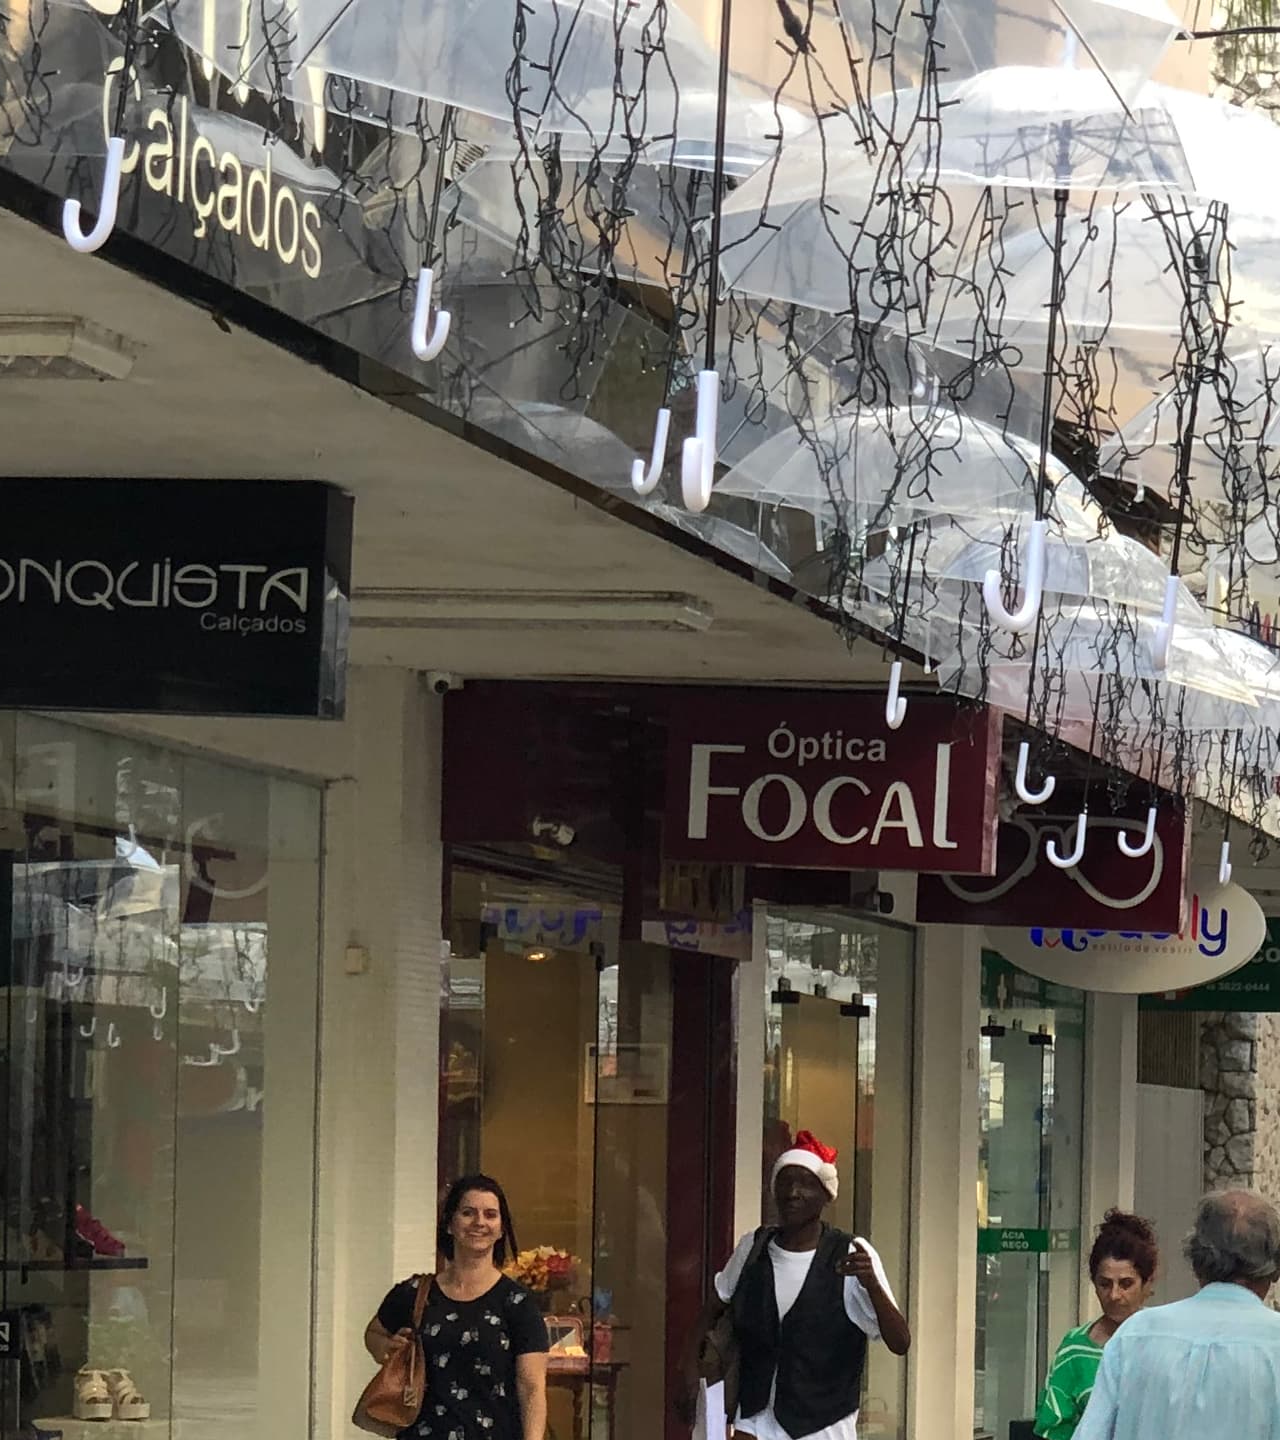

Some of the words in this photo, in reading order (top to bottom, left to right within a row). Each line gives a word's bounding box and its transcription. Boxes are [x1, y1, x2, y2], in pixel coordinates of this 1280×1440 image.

[103, 56, 322, 279] Calçados
[199, 611, 307, 636] Calçados
[767, 721, 888, 766] Óptica
